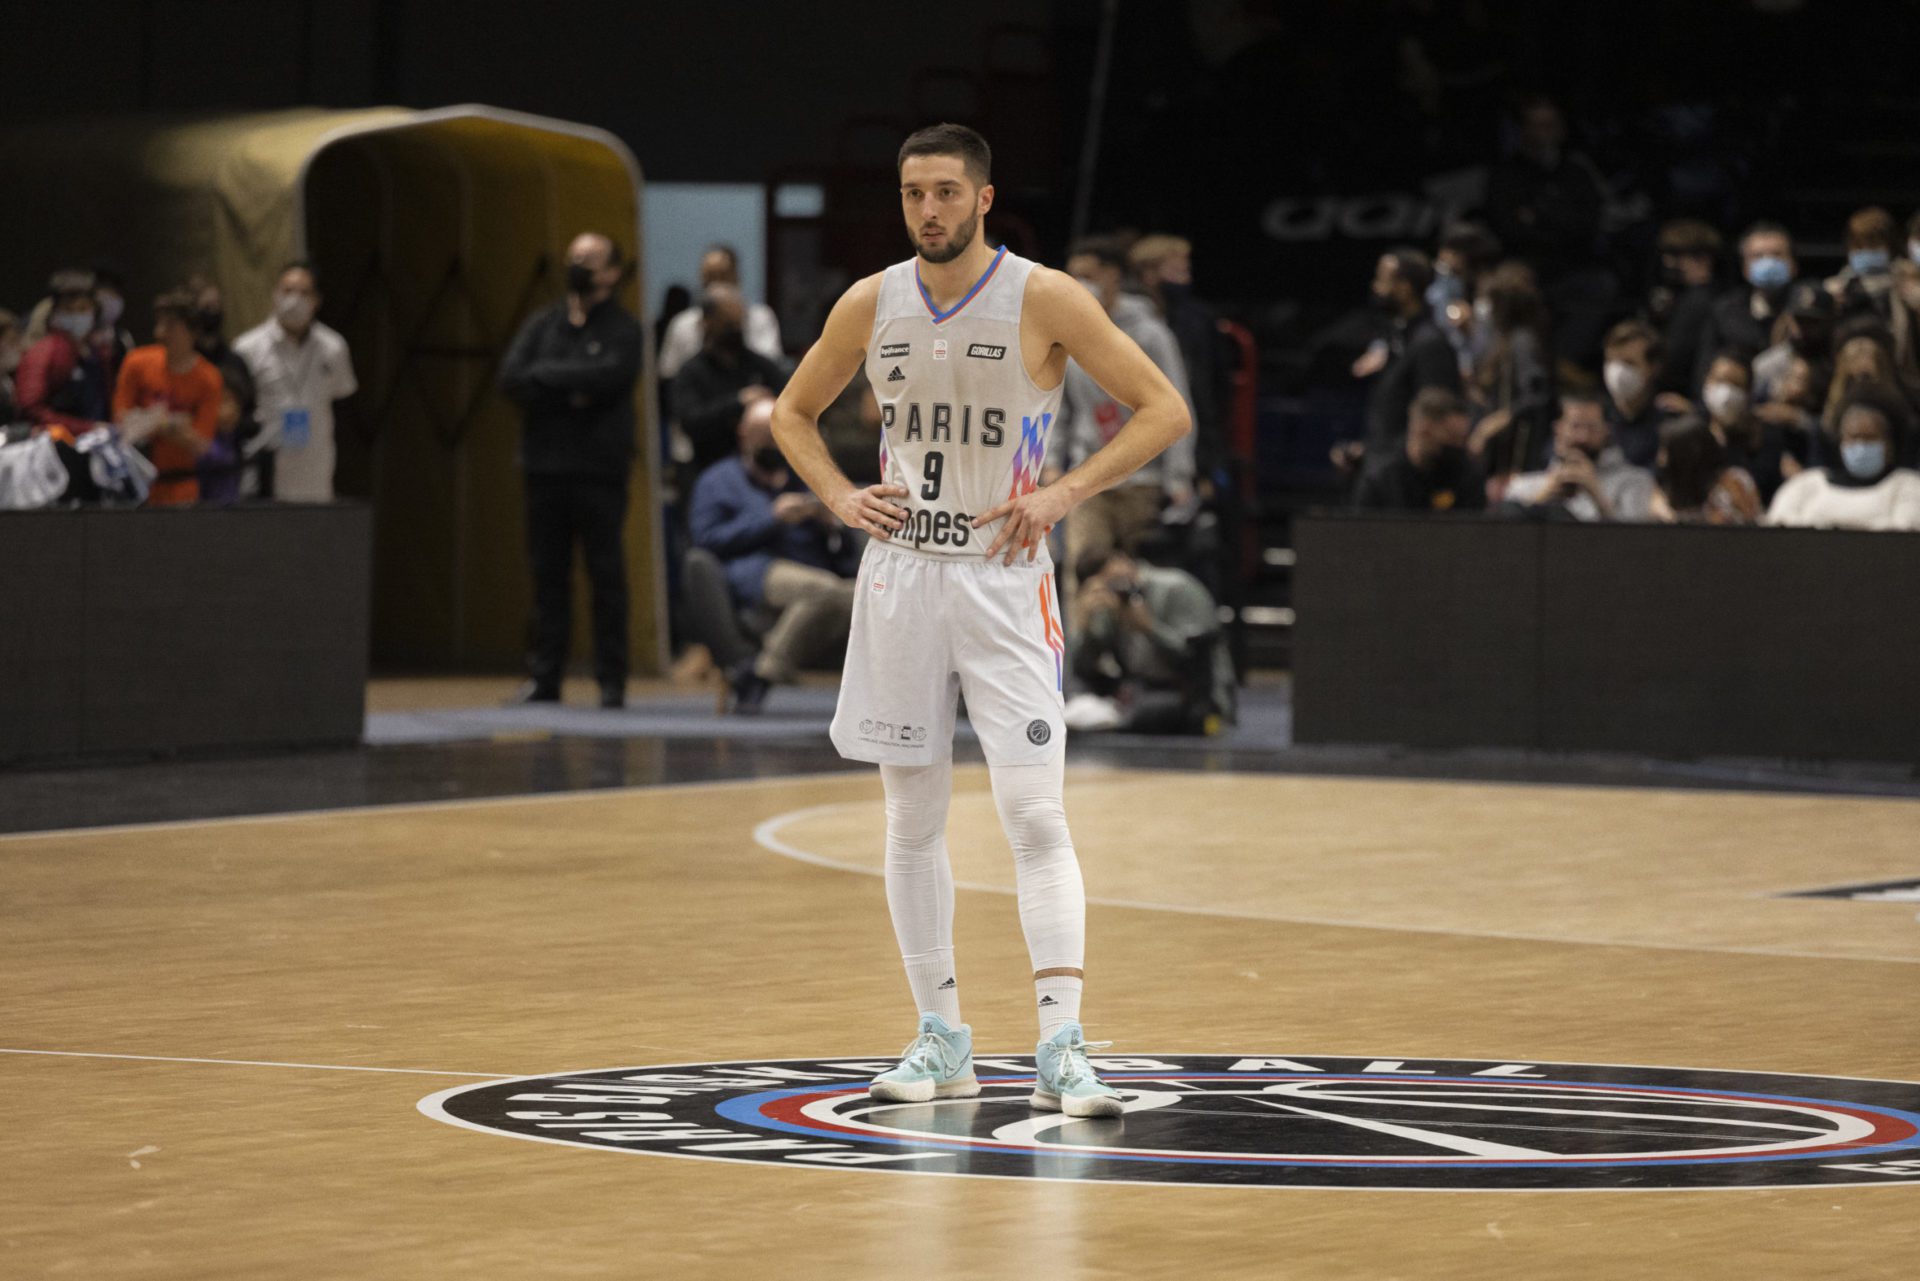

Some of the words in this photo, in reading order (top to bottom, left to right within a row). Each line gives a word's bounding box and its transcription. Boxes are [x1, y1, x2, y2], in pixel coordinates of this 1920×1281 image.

[971, 346, 1003, 358] GORILLAS
[882, 402, 1006, 448] PARIS
[921, 451, 944, 501] 9
